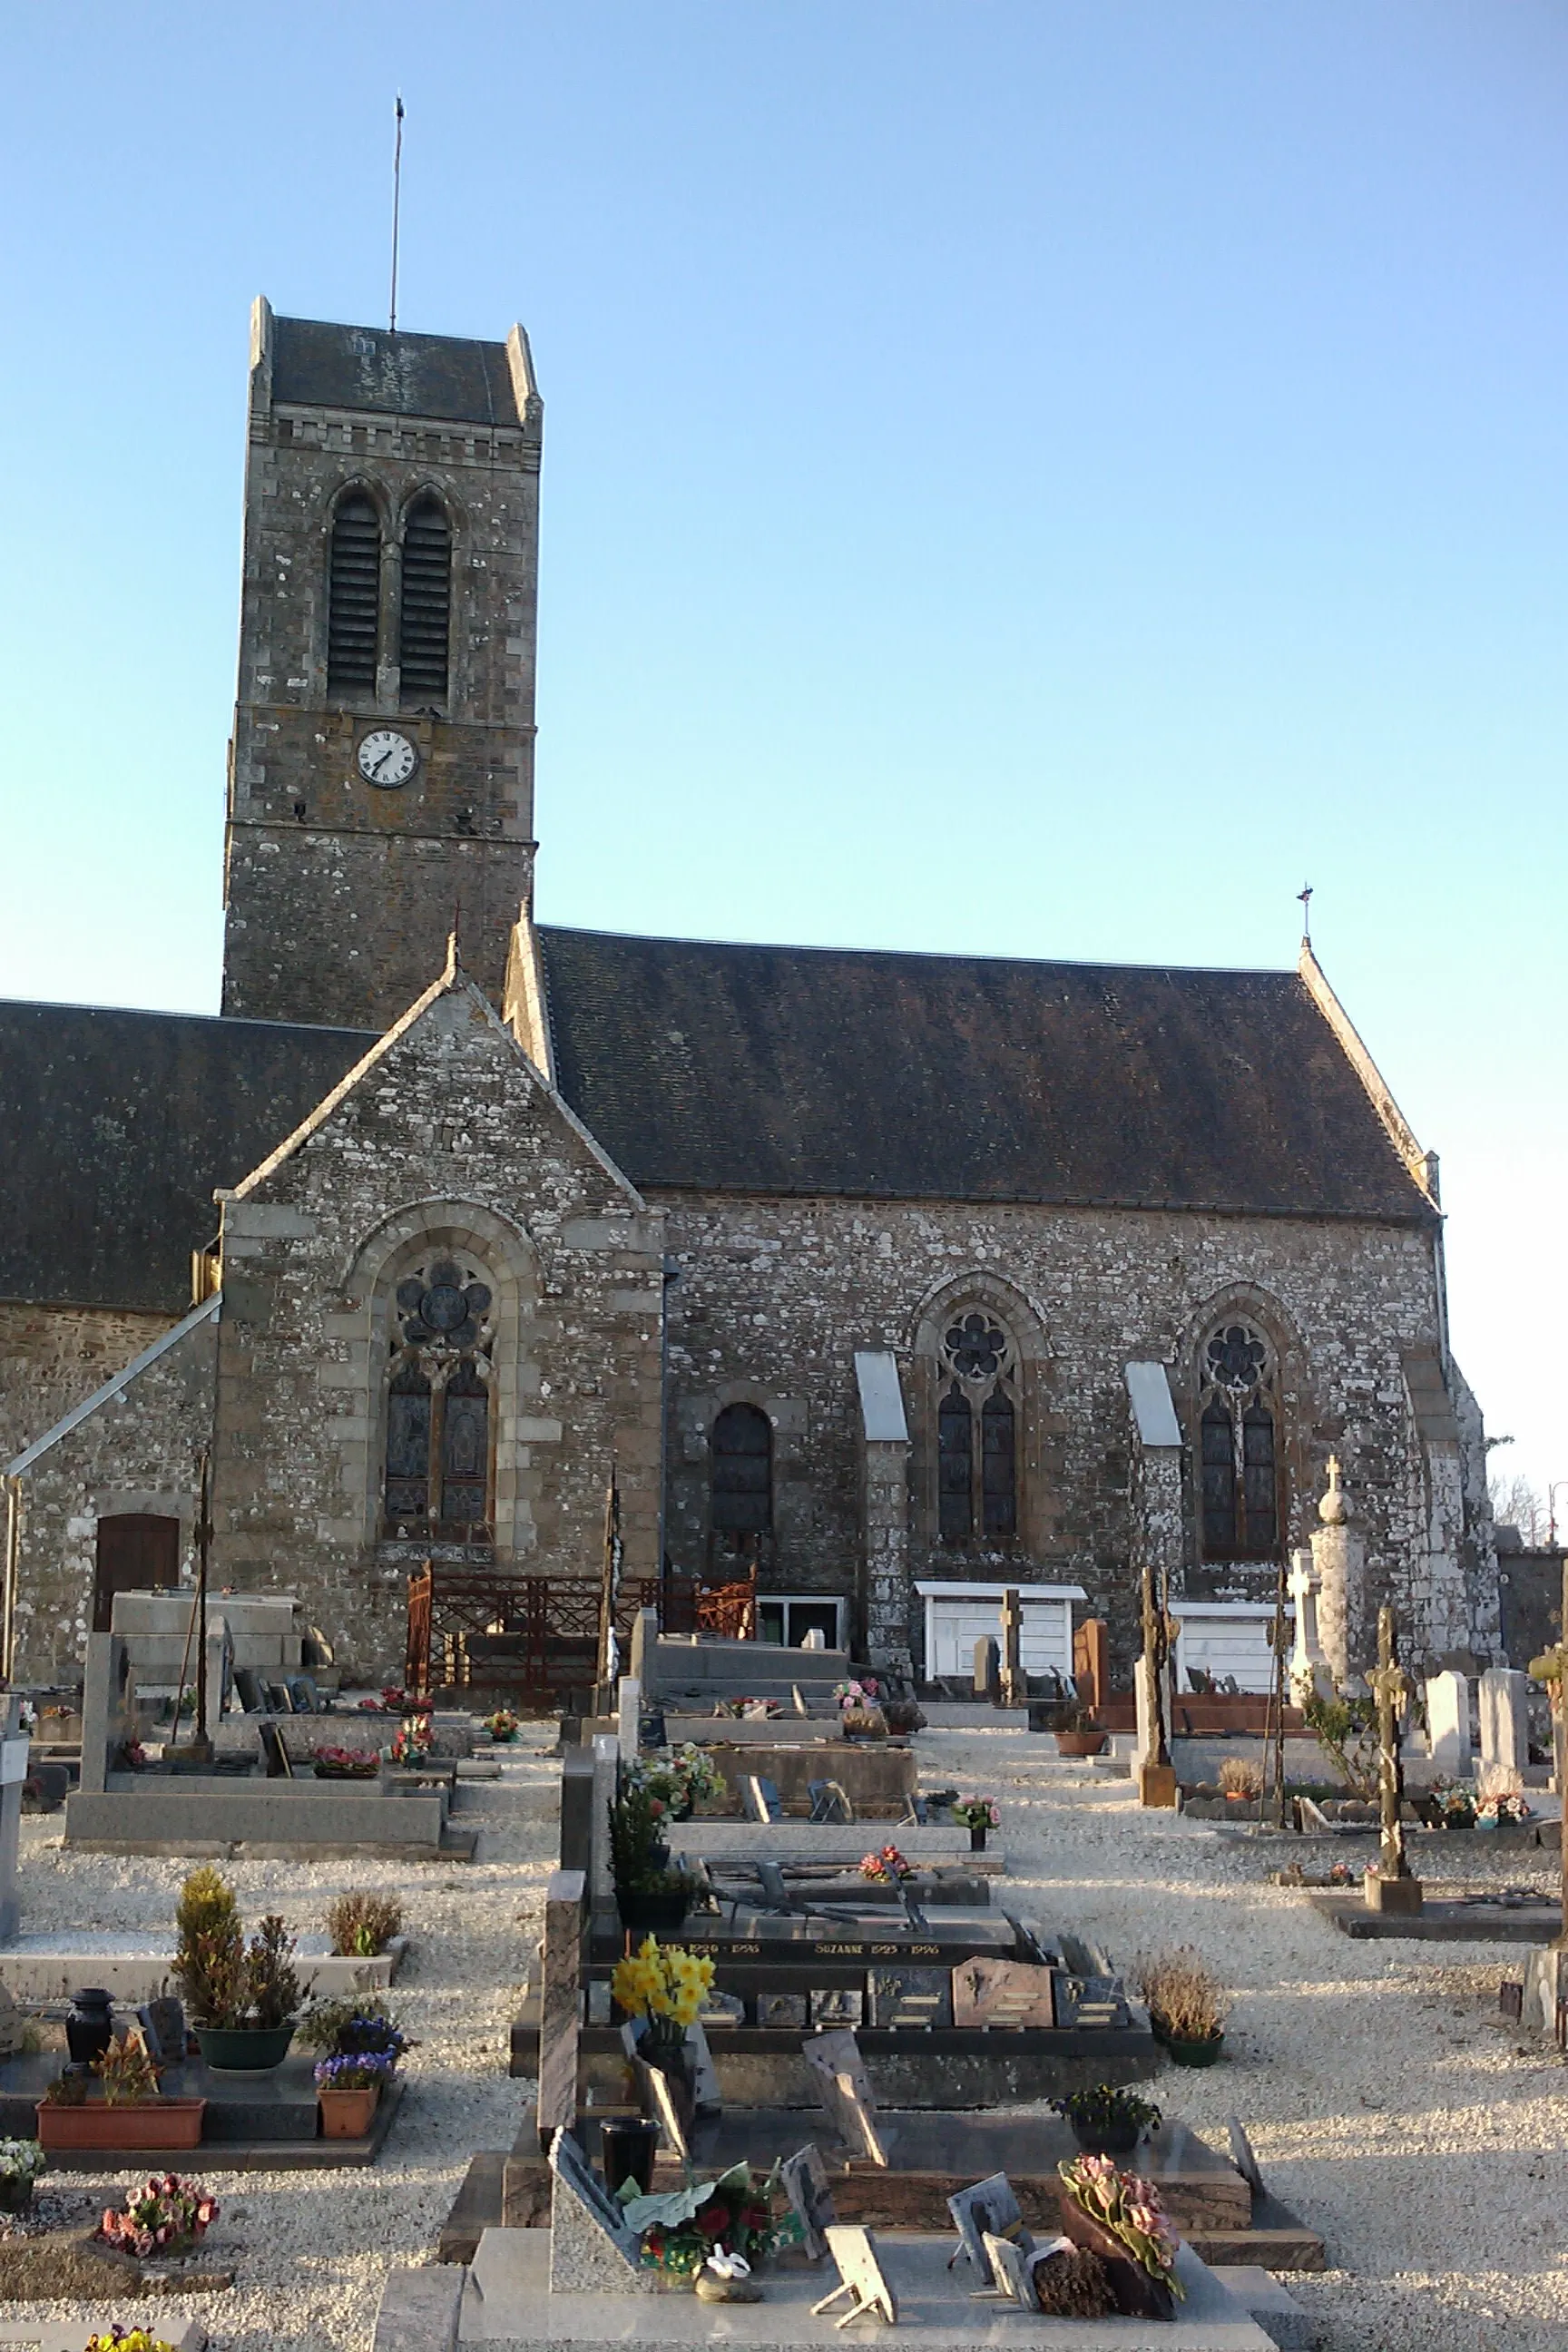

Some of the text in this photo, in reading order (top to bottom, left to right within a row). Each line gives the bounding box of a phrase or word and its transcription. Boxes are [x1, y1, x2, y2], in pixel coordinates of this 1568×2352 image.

[731, 1944, 760, 1953] 1996
[815, 1944, 864, 1954] SUZANNE
[910, 1945, 940, 1955] 1996
